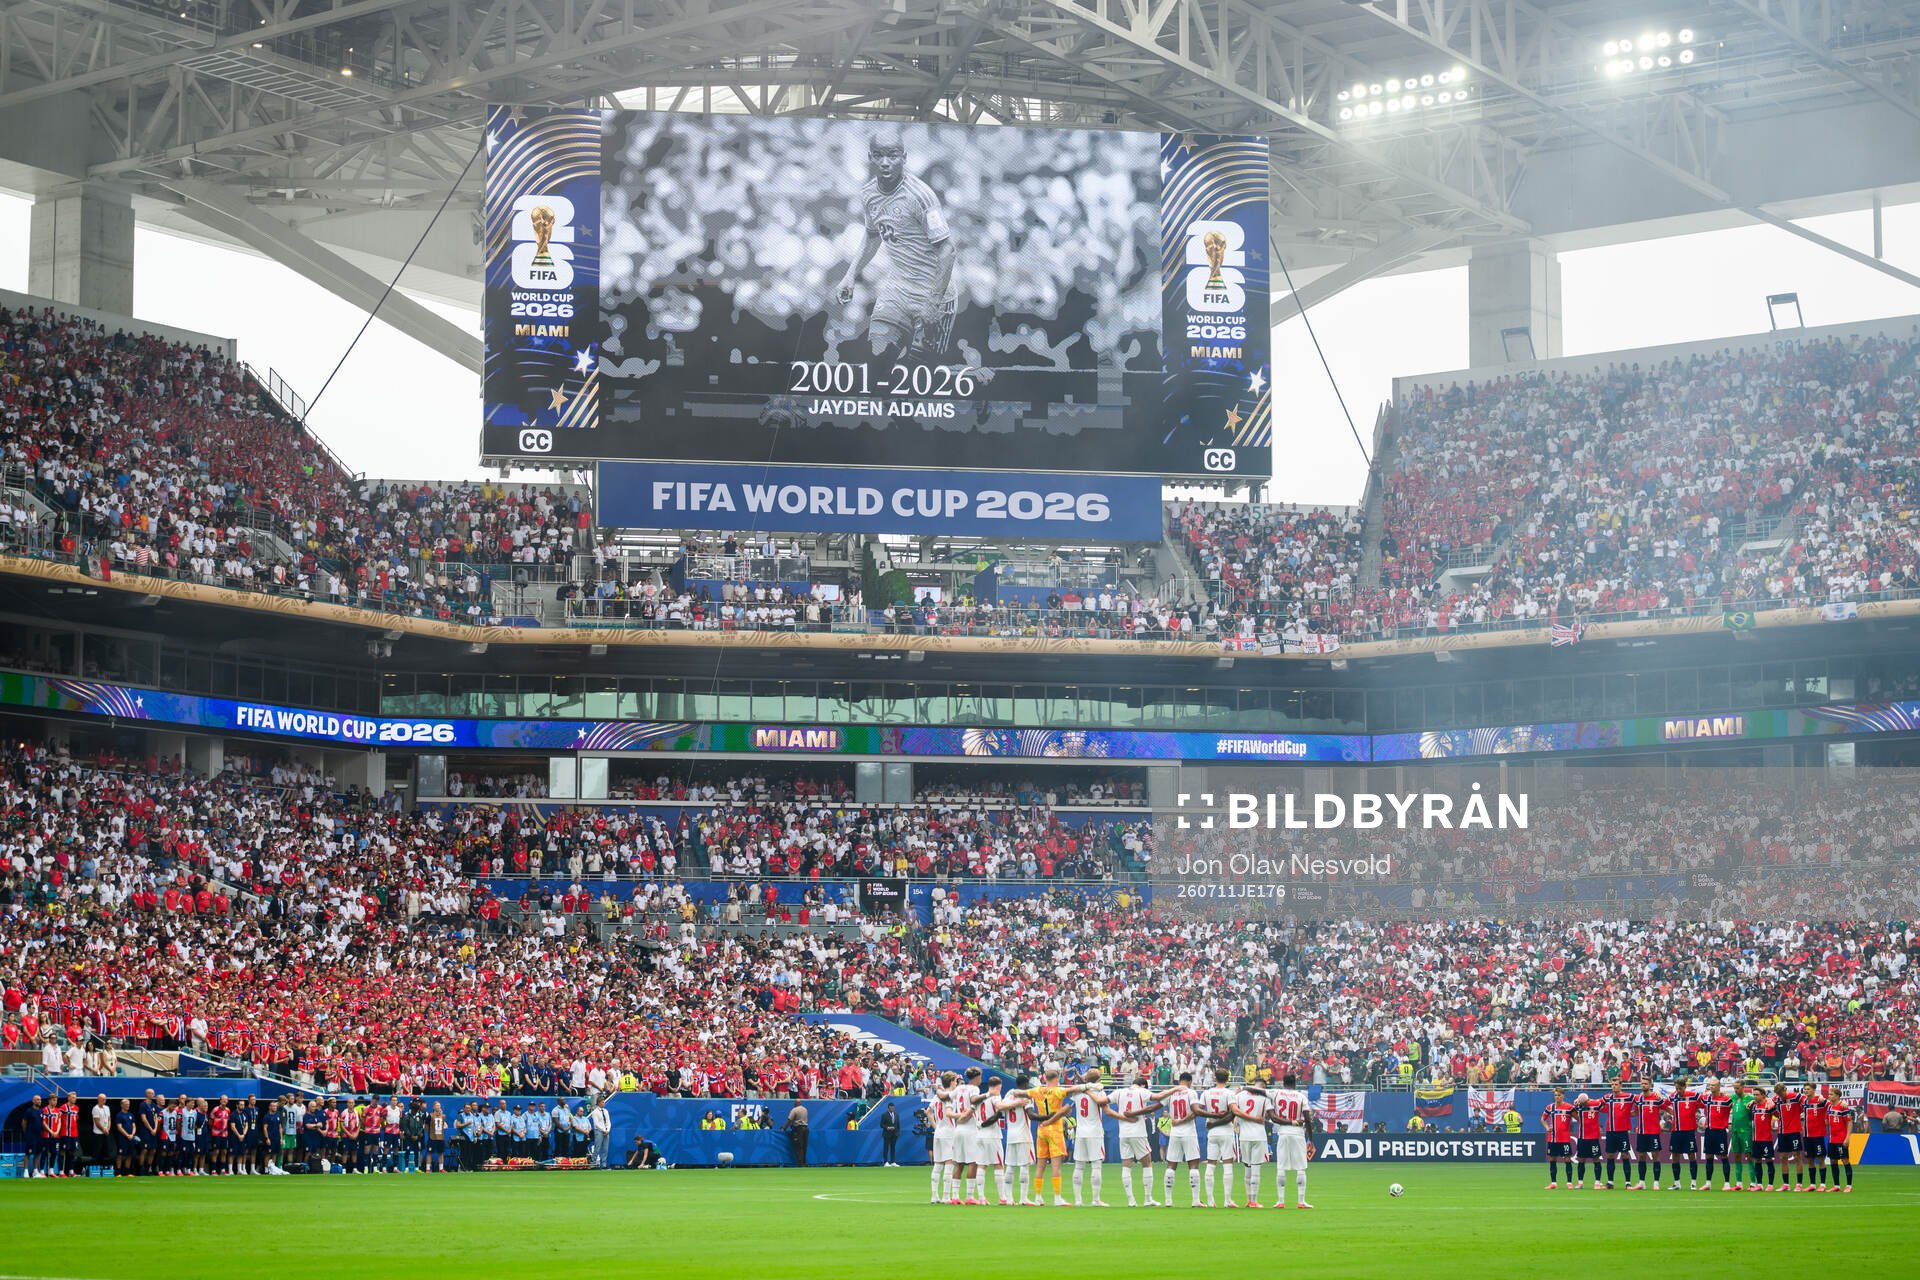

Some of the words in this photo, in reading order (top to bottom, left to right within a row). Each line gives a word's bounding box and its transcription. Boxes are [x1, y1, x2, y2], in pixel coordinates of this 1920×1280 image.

[530, 270, 557, 281] FIFA
[511, 292, 551, 302] WORLD
[552, 293, 574, 303] CUP
[1203, 293, 1230, 304] FIFA
[511, 302, 574, 318] 2026
[1186, 315, 1224, 324] WORLD
[1225, 316, 1246, 325] CUP
[515, 323, 570, 338] MIAMI
[1186, 325, 1247, 340] 2026
[1191, 345, 1243, 359] MIAMI
[790, 361, 975, 397] 2001-2026
[808, 400, 883, 418] JAYDEN
[887, 401, 956, 419] ADAMS
[521, 432, 550, 449] CC
[1206, 451, 1234, 468] CC
[652, 481, 737, 512] FIFA
[742, 483, 884, 516] WORLD
[891, 487, 969, 518] CUP
[975, 489, 1110, 522] 2026
[237, 705, 275, 729] FIFA
[278, 711, 340, 736] WORLD
[342, 719, 377, 740] CUP
[379, 723, 456, 743] 2026
[1664, 715, 1744, 740] MIAMI
[756, 729, 838, 749] MIAMI
[1216, 738, 1307, 758] #FIFAWorldCup
[1044, 1098, 1049, 1115] 1
[1080, 1097, 1089, 1117] 9
[1125, 1101, 1132, 1112] 4
[1211, 1099, 1220, 1114] 5
[1246, 1099, 1255, 1115] 2
[1868, 1092, 1897, 1105] PARMO
[1899, 1096, 1920, 1108] ARMY
[1172, 1099, 1187, 1120] 10
[1278, 1099, 1299, 1121] 20
[1320, 1139, 1372, 1159] ADI
[1379, 1140, 1536, 1157] PREDICTSTREET
